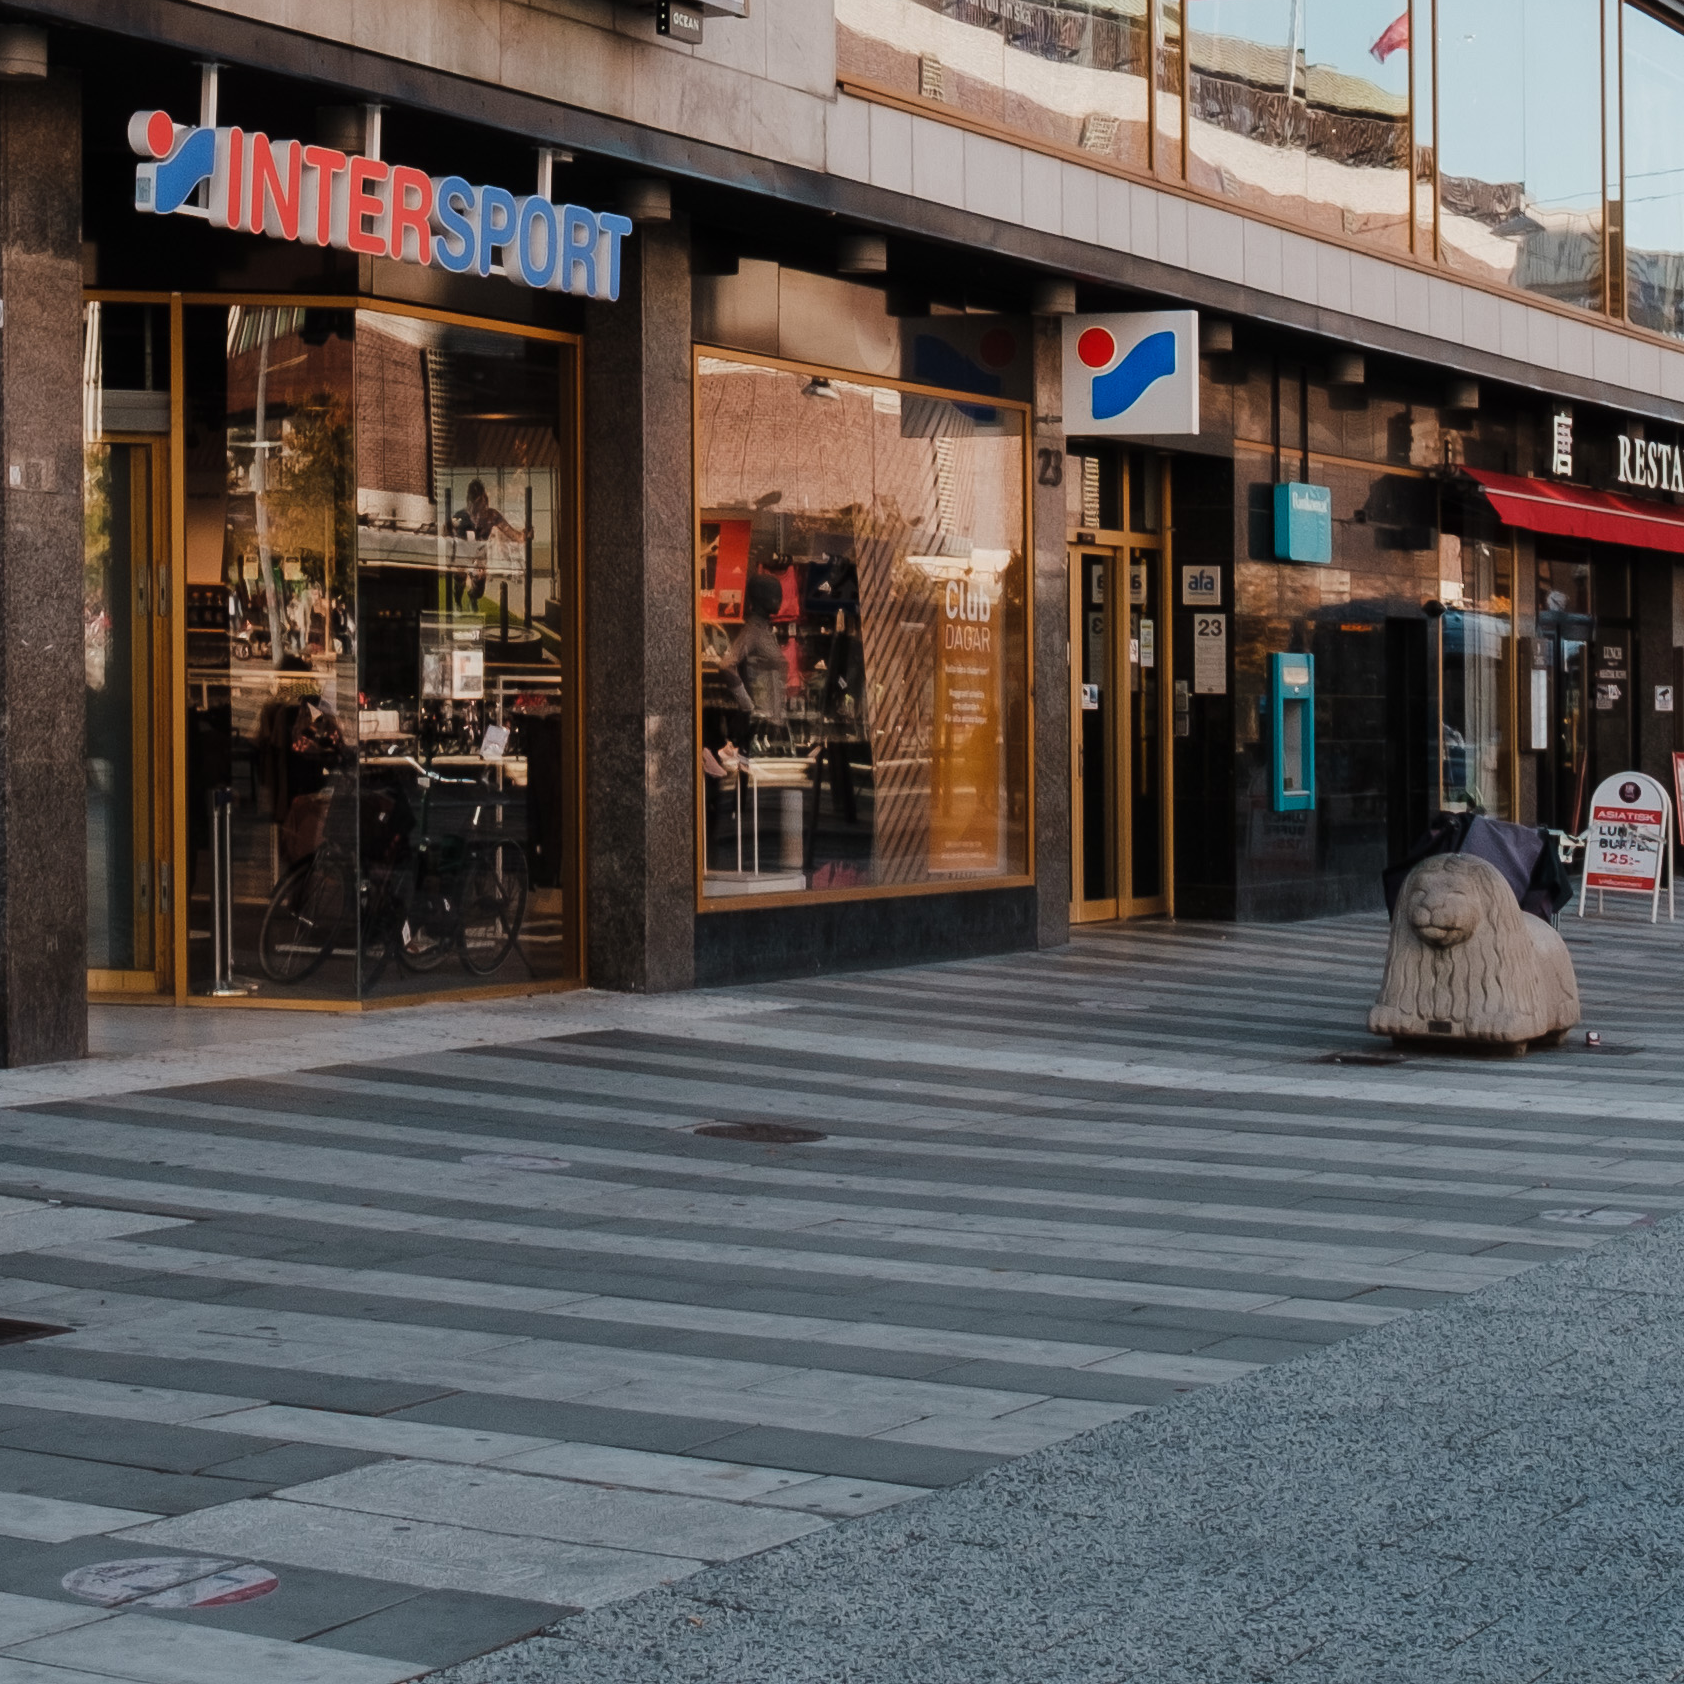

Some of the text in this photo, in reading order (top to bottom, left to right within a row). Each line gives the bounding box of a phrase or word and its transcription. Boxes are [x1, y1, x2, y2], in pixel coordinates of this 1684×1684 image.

[672, 11, 700, 31] OCEAN
[224, 126, 634, 302] INTERSPORT
[1037, 447, 1063, 487] 23
[1187, 569, 1215, 592] afa
[946, 580, 991, 623] Club
[945, 623, 991, 653] DAGAR
[1197, 618, 1223, 637] 23
[1597, 810, 1657, 823] ASIATISK
[1602, 851, 1641, 866] 125:-
